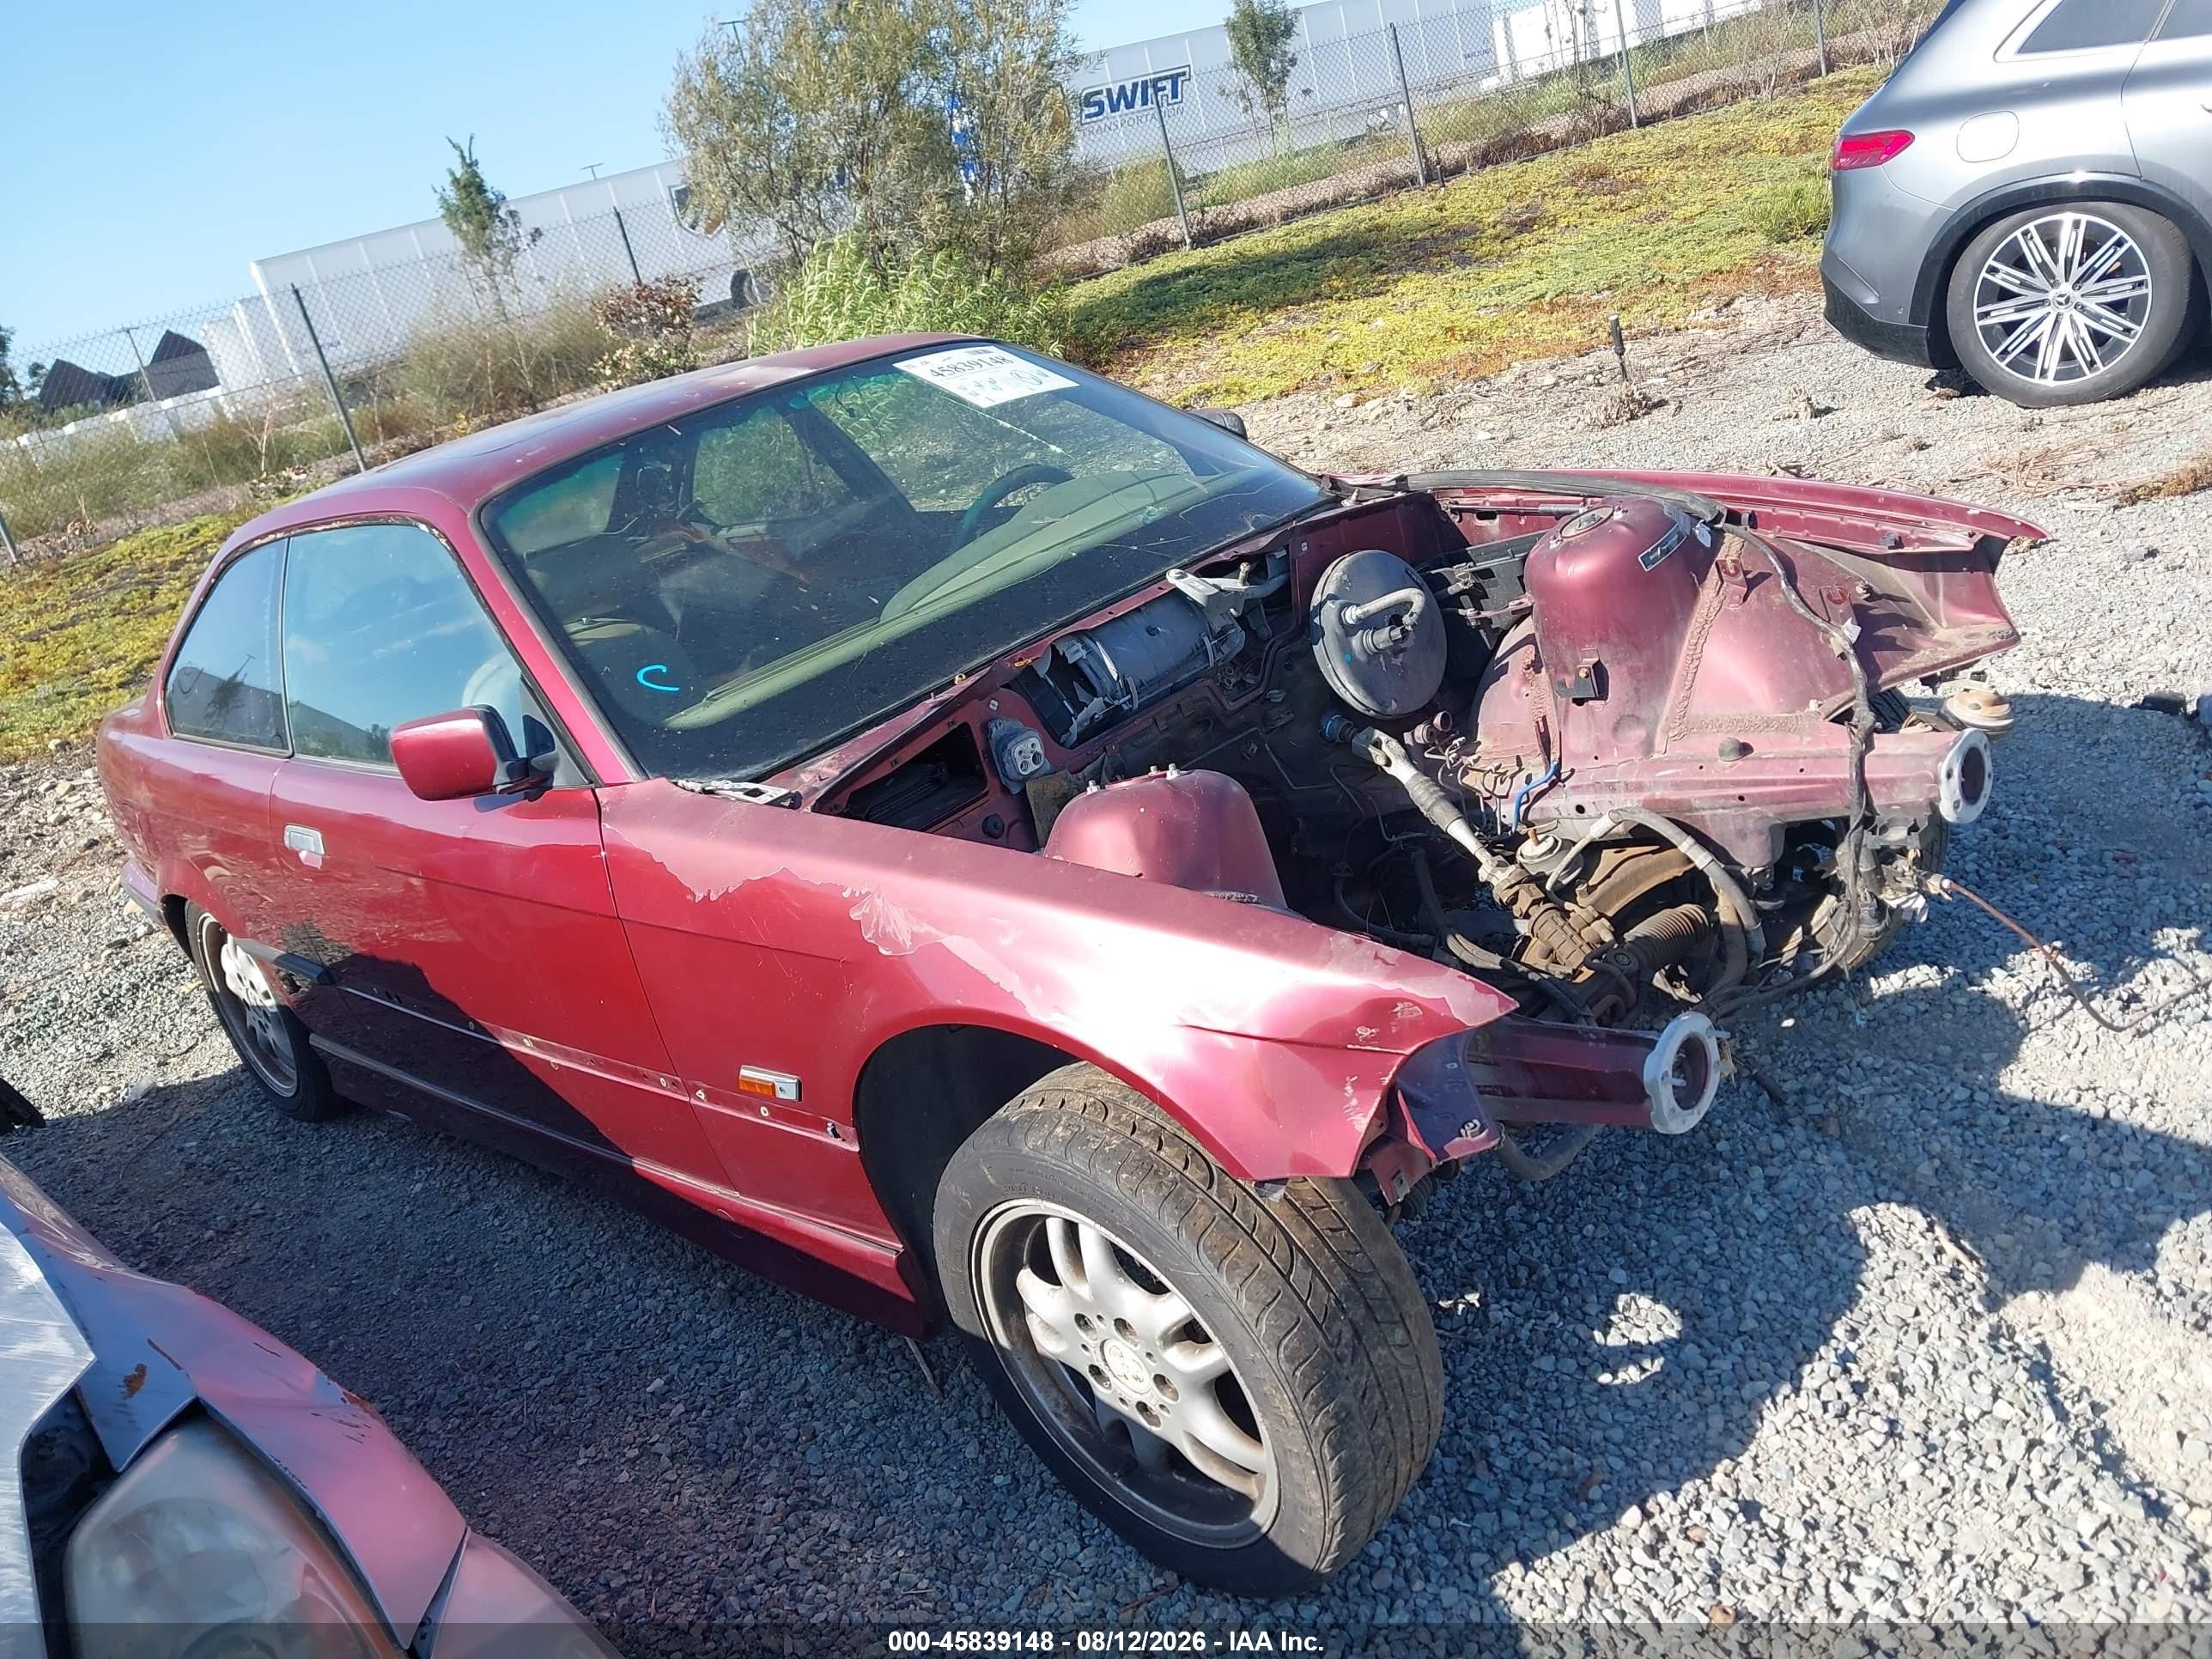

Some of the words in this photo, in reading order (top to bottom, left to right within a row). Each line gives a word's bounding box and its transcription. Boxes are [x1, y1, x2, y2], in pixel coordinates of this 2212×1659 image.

[1083, 70, 1187, 119] SWIFT
[1079, 106, 1185, 138] TRANSPORTAION
[929, 356, 1014, 378] 45839148
